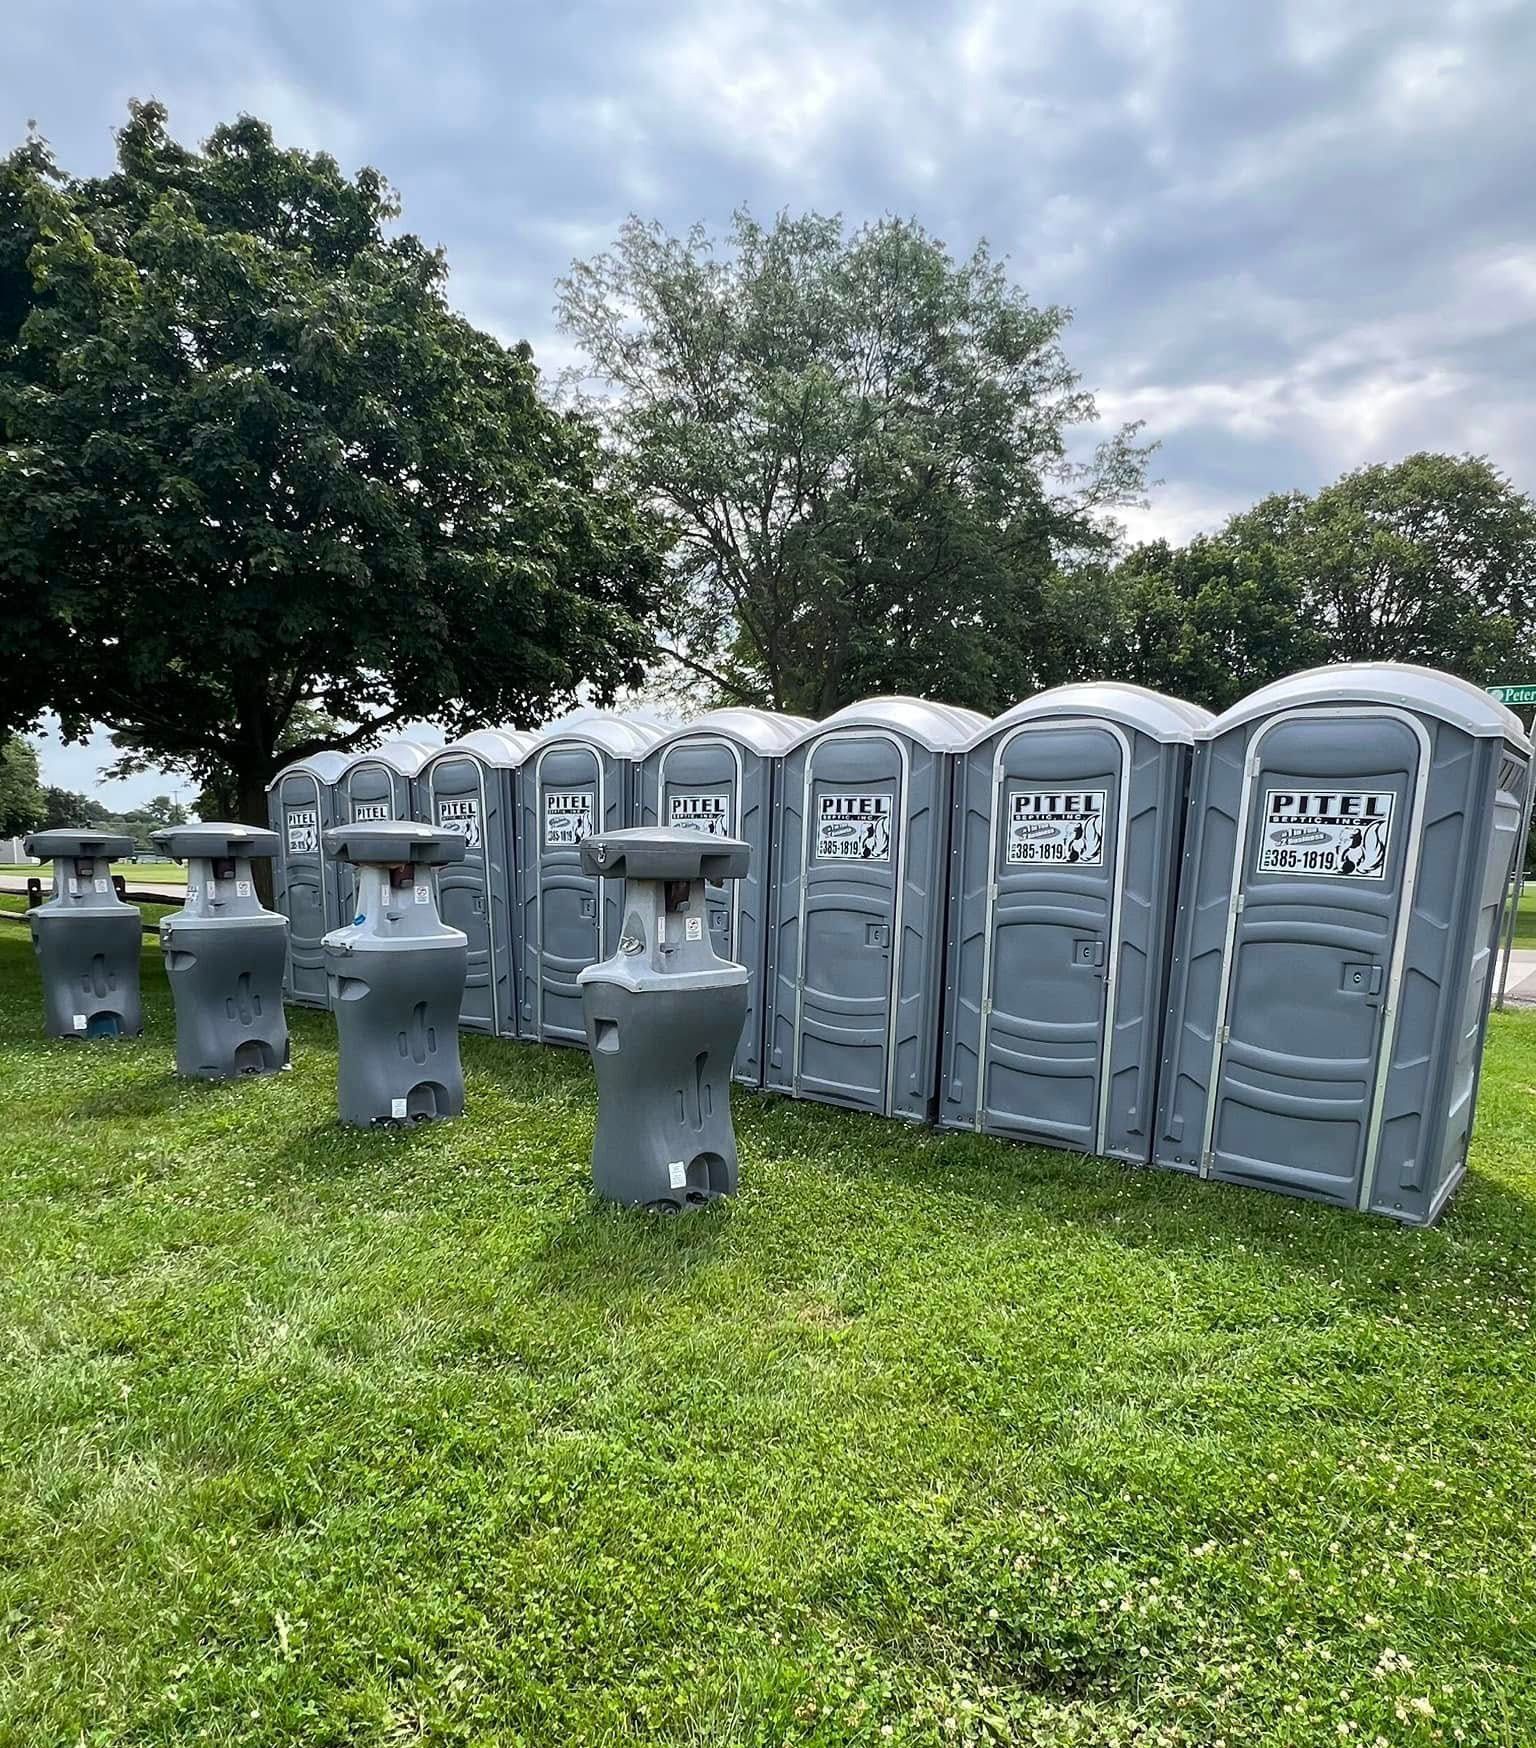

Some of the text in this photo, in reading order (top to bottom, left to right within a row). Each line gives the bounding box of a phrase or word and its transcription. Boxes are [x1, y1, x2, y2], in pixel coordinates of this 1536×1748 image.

[441, 802, 476, 816] PITEL
[548, 796, 590, 809] PITEL
[672, 798, 725, 813] PITEL
[822, 798, 887, 814] PITEL
[1015, 795, 1100, 813] PITEL
[1272, 795, 1385, 816] PITEL
[288, 812, 315, 825] PITEL
[357, 807, 387, 819] PITEL
[823, 840, 859, 856] 385-1819
[1016, 843, 1063, 860] 385-1819
[1270, 849, 1334, 870] 385-1819
